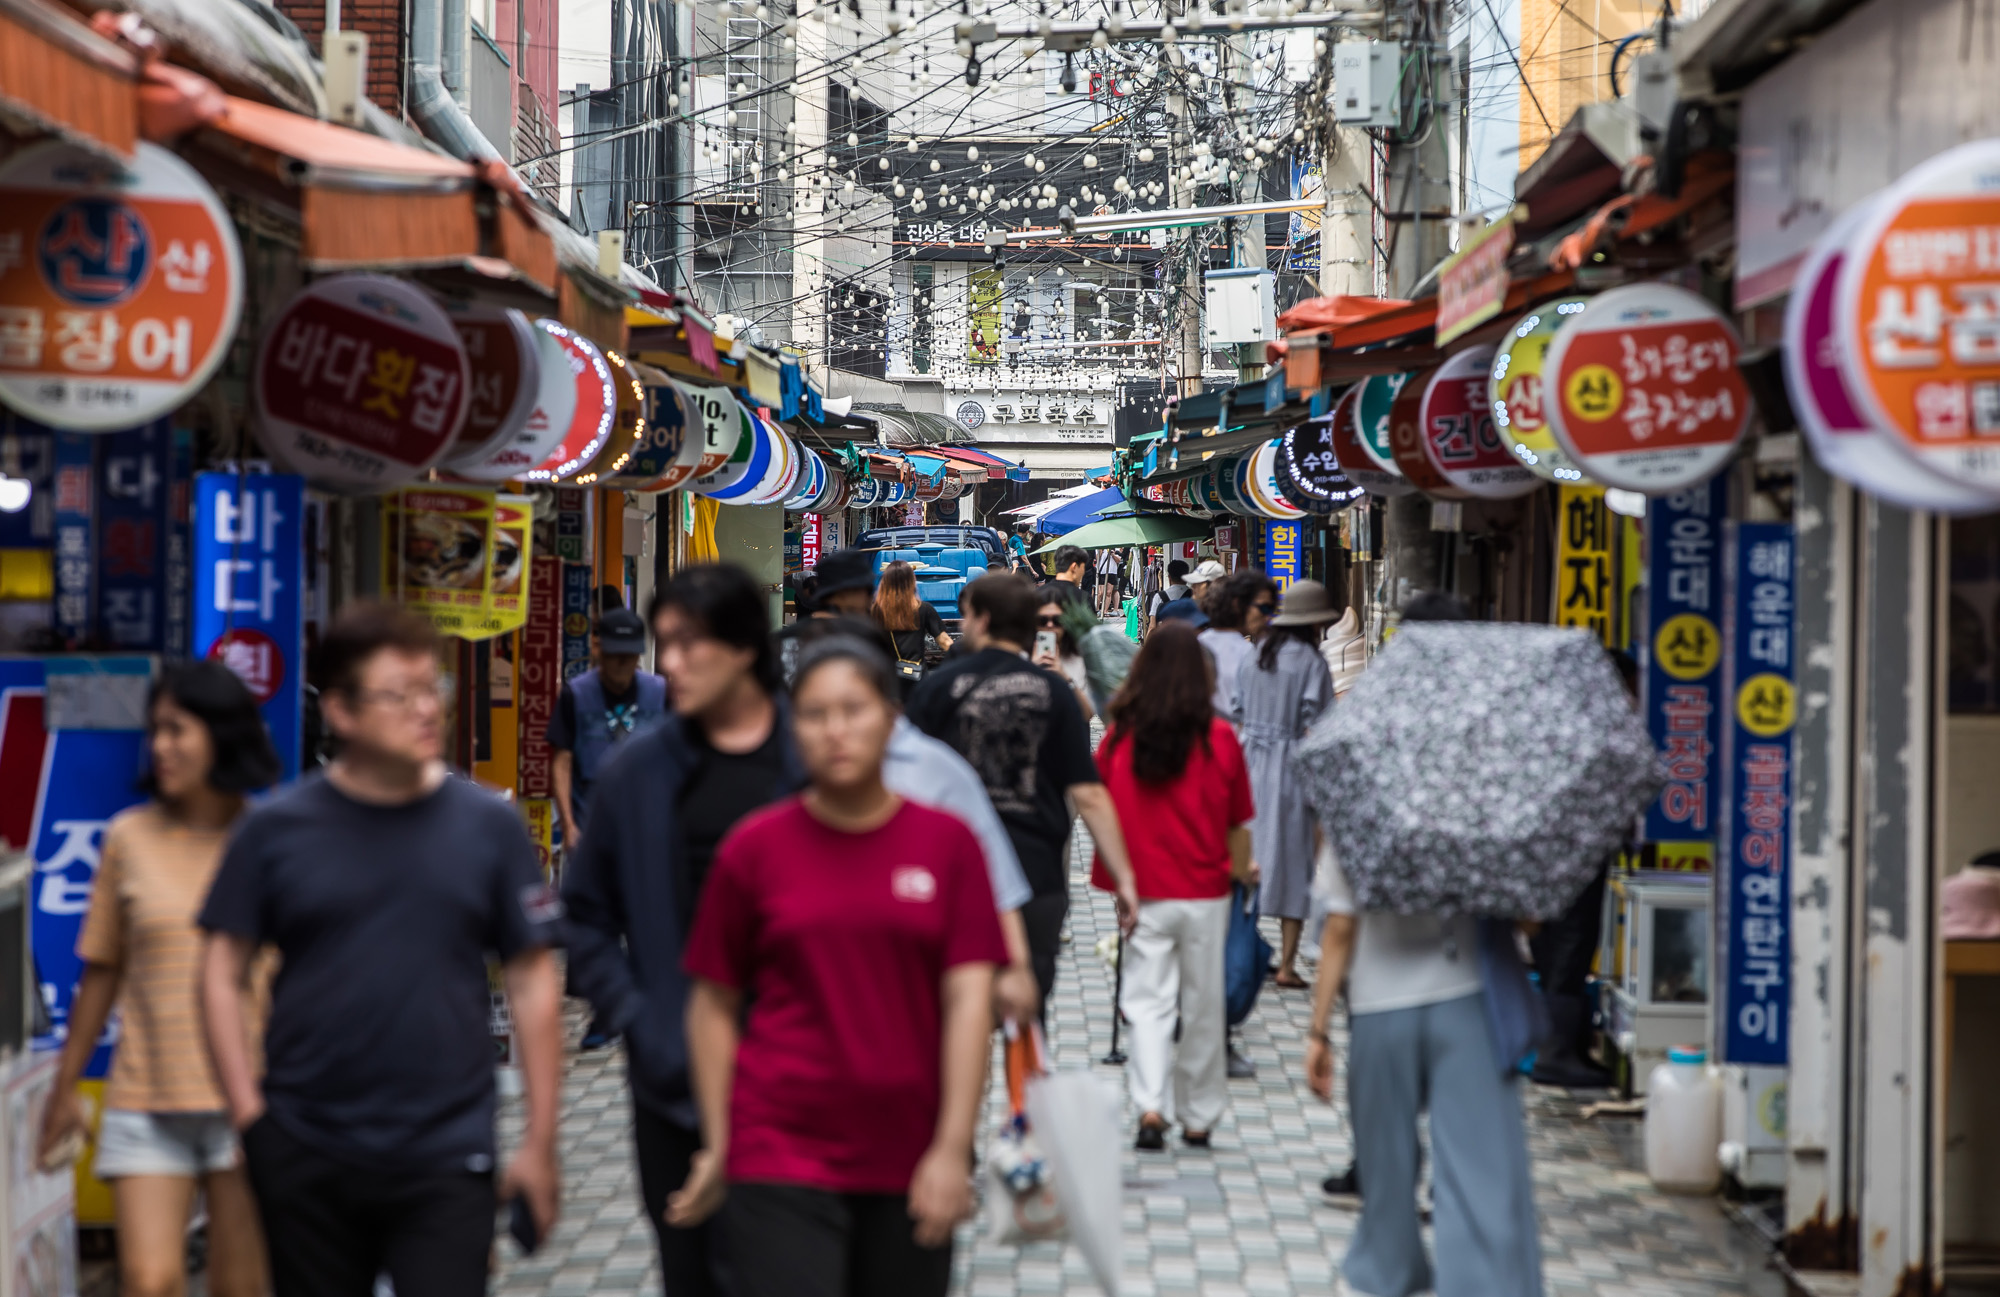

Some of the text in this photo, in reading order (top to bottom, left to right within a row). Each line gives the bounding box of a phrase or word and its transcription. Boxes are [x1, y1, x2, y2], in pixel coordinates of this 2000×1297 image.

[906, 223, 955, 243] 진심을
[275, 314, 458, 436] 바다횟집
[1579, 374, 1611, 413] 산
[992, 404, 1096, 427] 구포국수
[214, 488, 285, 624] 바다
[566, 569, 588, 612] 바다
[1746, 540, 1793, 669] 해운대
[1664, 625, 1710, 672] 산
[1746, 684, 1789, 728] 산
[1737, 869, 1789, 1046] 연탄구이
